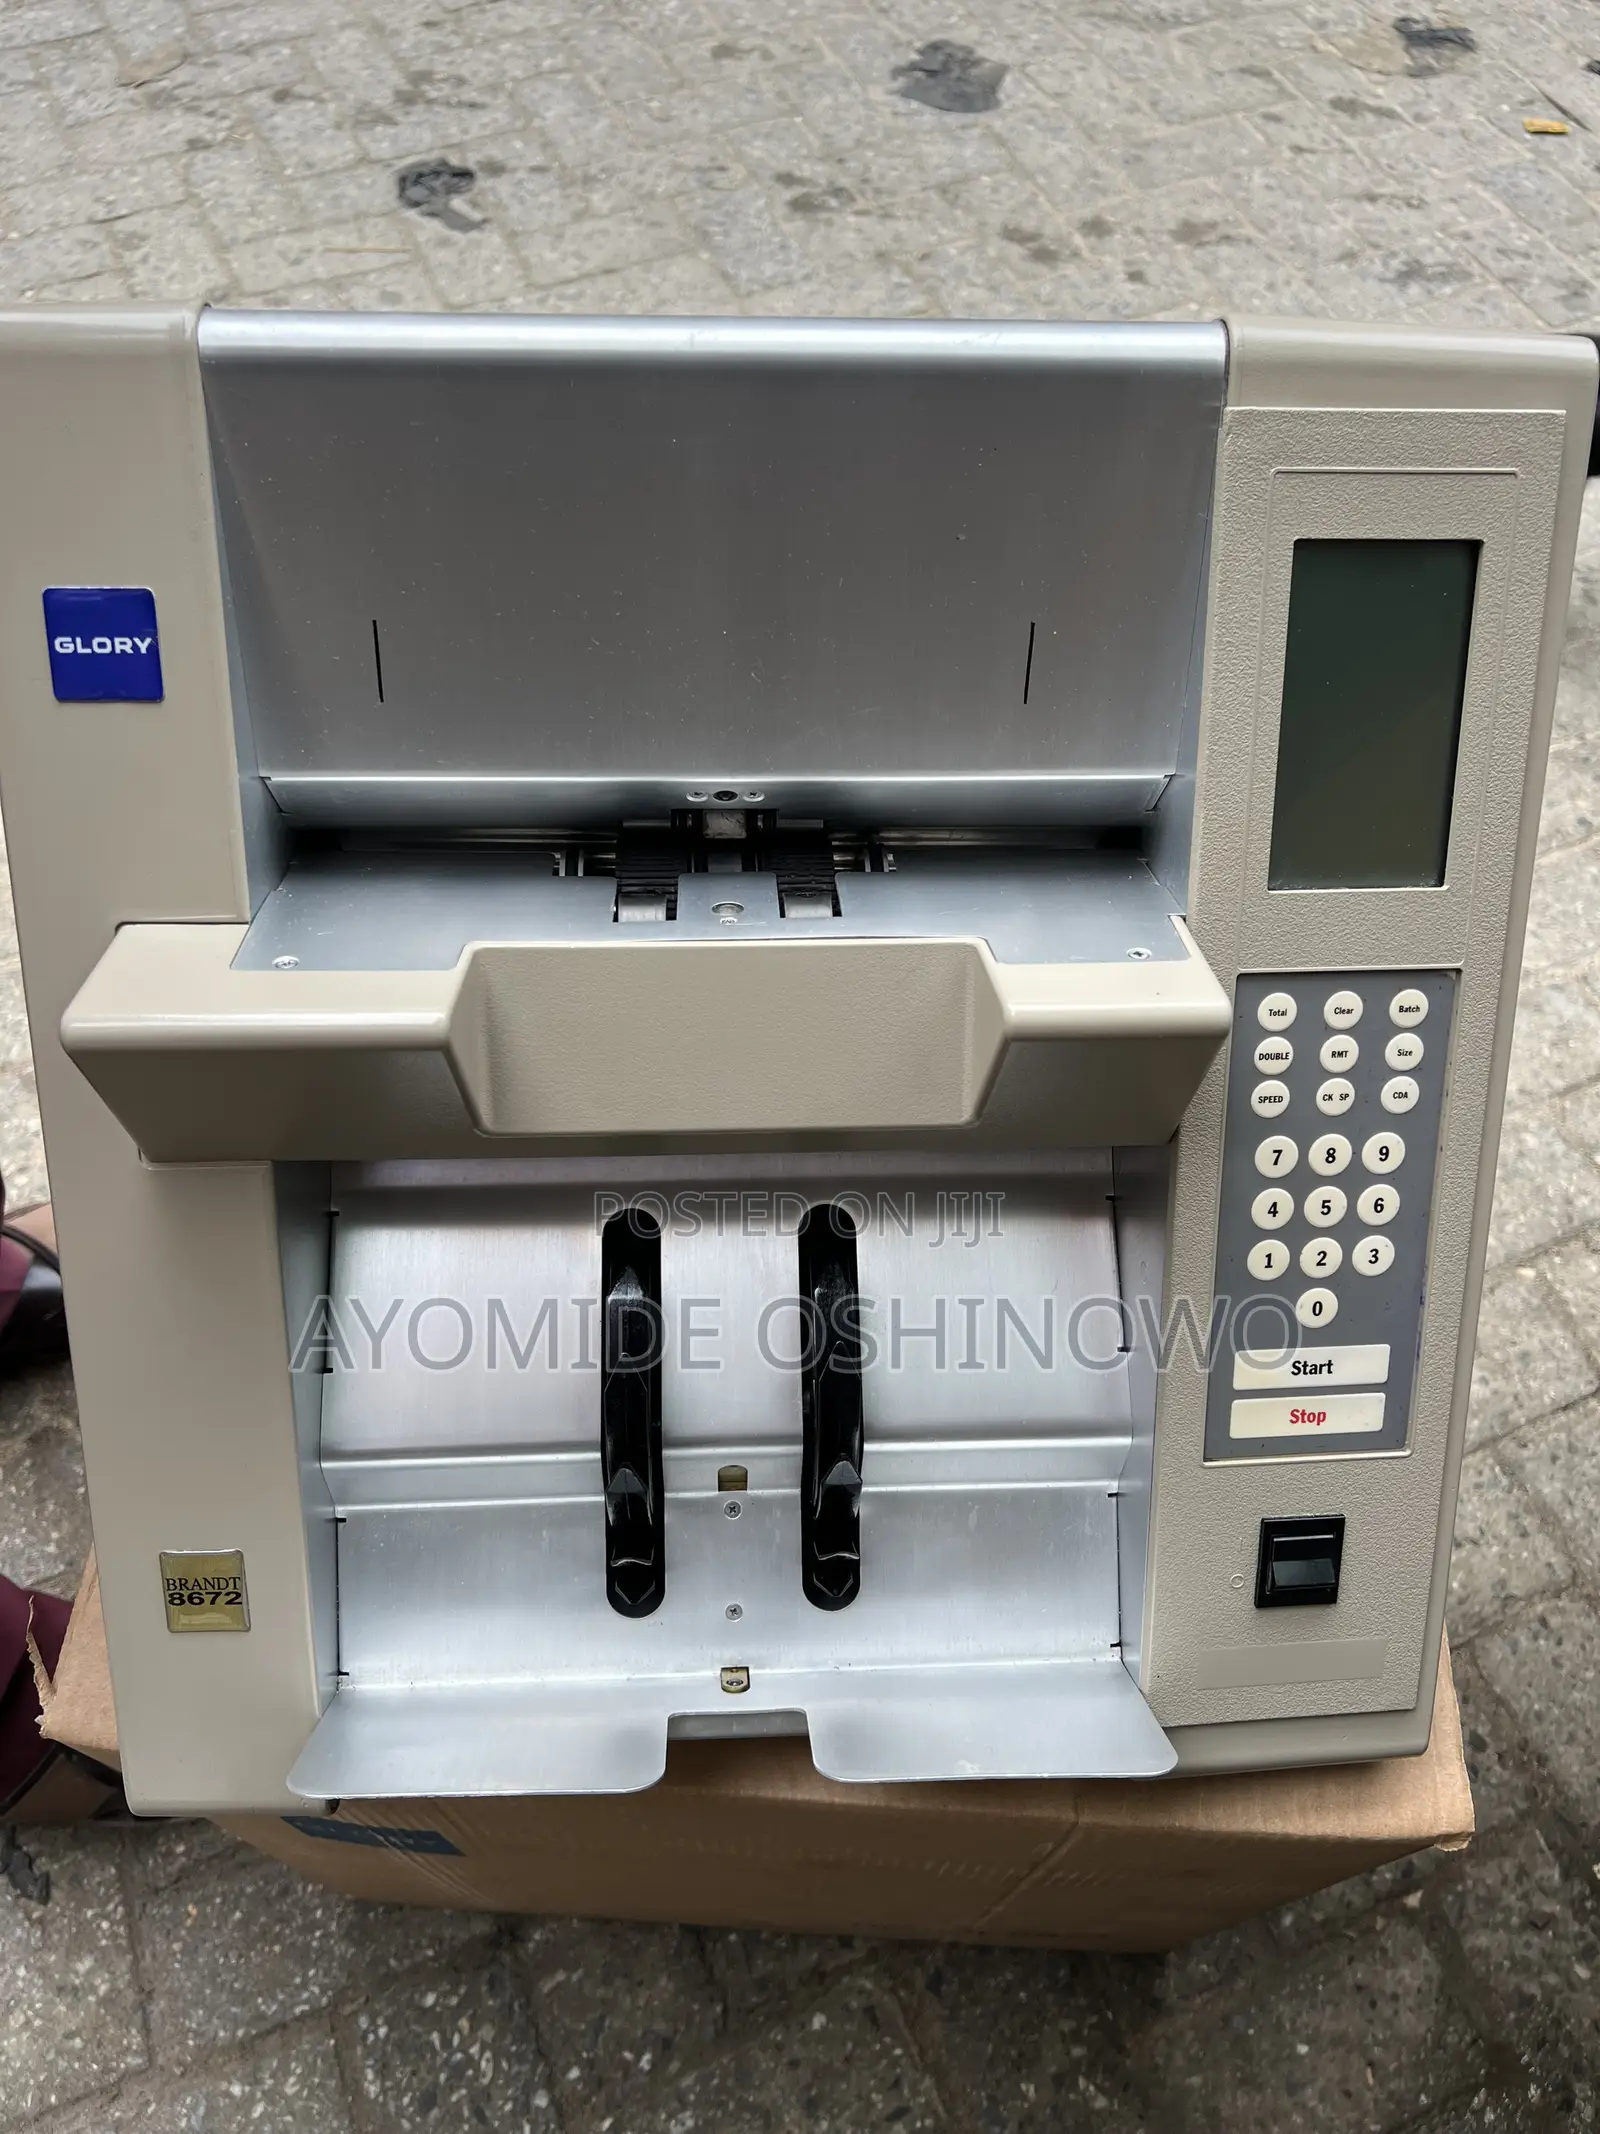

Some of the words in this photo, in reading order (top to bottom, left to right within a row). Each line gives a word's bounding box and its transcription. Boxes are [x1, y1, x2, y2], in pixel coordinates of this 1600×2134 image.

[54, 636, 152, 654] GLORY
[1268, 1008, 1288, 1017] Total
[1333, 1006, 1355, 1015] Clear
[1398, 1005, 1421, 1014] Batch
[1258, 1051, 1290, 1061] DOUBLE
[1331, 1050, 1349, 1059] RMT
[1396, 1048, 1413, 1057] Size
[1257, 1095, 1284, 1104] SPEED
[1322, 1093, 1334, 1102] CK
[1338, 1093, 1350, 1102] SP
[1392, 1091, 1409, 1100] CDA
[1272, 1149, 1284, 1166] 7
[1324, 1147, 1337, 1165] 8
[1378, 1145, 1390, 1163] 9
[1267, 1201, 1279, 1218] 4
[1320, 1199, 1332, 1216] 5
[1373, 1197, 1385, 1214] 6
[1264, 1252, 1274, 1269] 1
[1315, 1250, 1328, 1267] 2
[1368, 1248, 1380, 1265] 3
[1311, 1300, 1324, 1317] 0
[1290, 1359, 1334, 1377] Start
[1289, 1408, 1327, 1427] Stop
[165, 1576, 241, 1591] BRANDT
[168, 1591, 243, 1606] 8672
